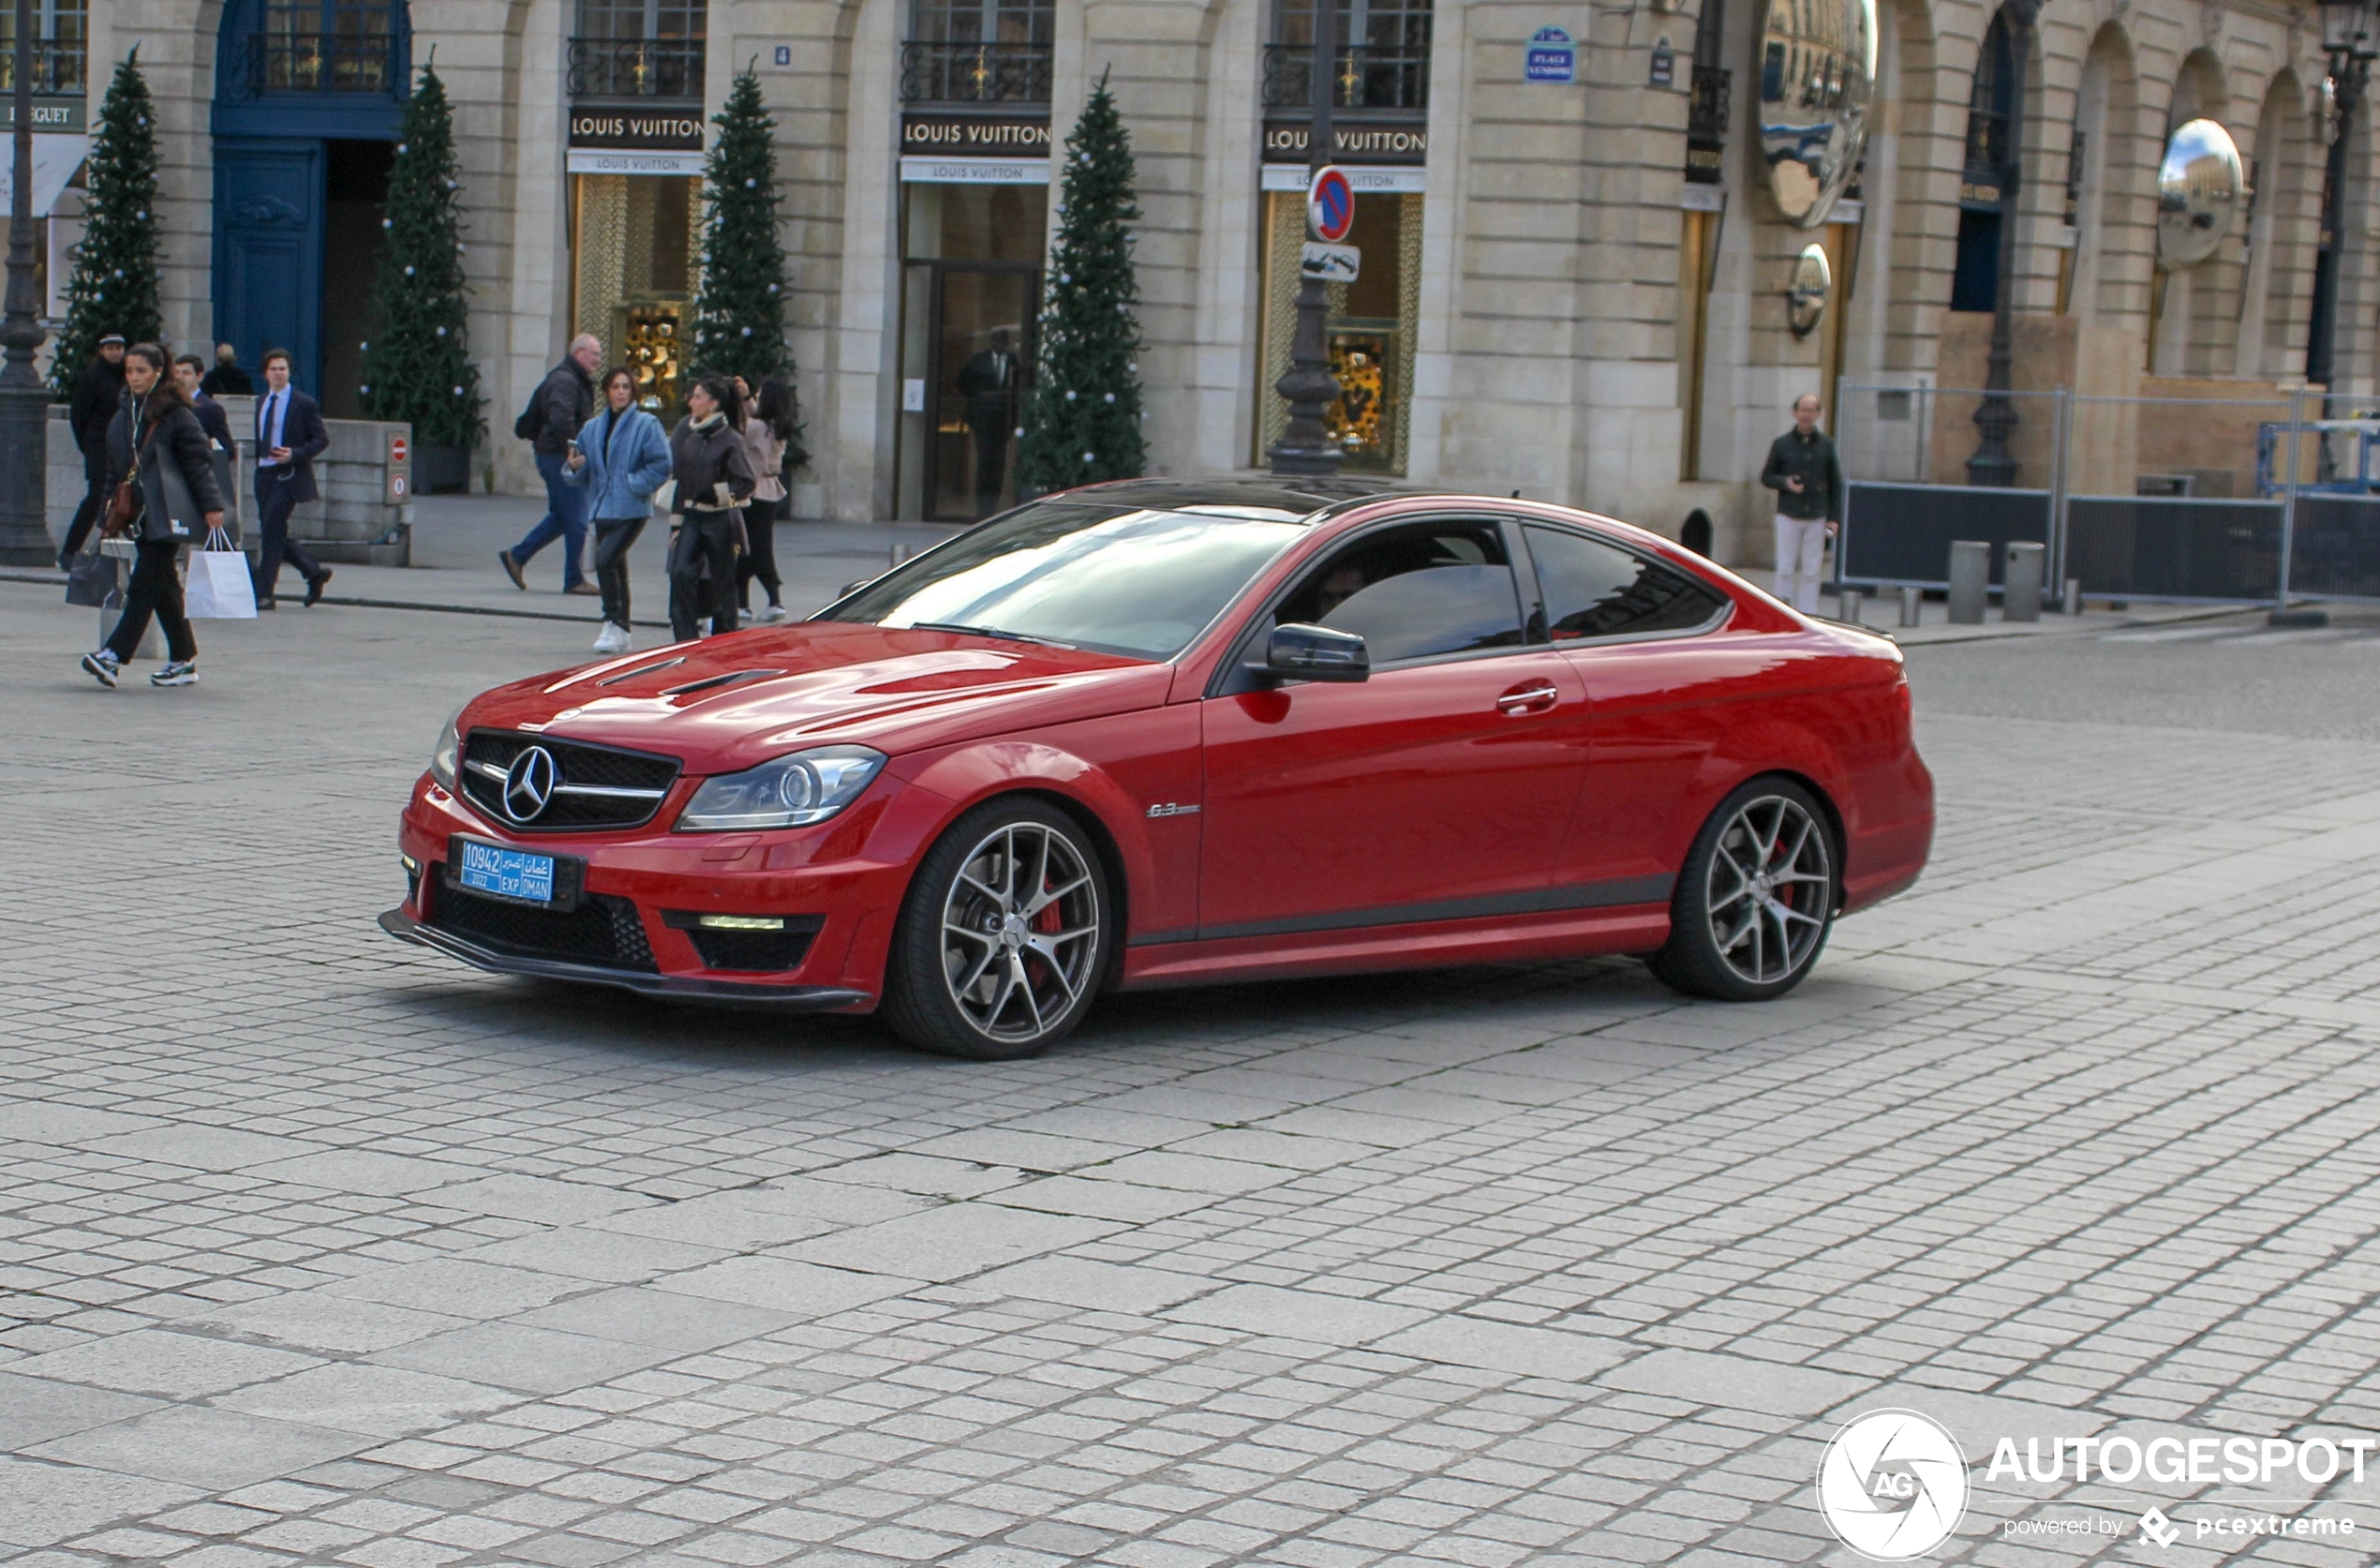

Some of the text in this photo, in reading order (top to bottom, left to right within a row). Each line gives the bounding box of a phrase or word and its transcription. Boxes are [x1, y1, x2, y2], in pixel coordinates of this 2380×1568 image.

[778, 48, 787, 63] 4
[572, 118, 706, 138] LOUIS VUITTON
[905, 124, 1051, 145] LOUIS VUITTON
[1267, 130, 1426, 152] LOU VUITTON
[597, 158, 680, 170] LOUIS VUITTON
[933, 166, 1023, 179] LOUIS VUITTON
[1351, 175, 1394, 187] UITTON
[466, 844, 500, 874] 10942
[471, 874, 548, 897] 2022 EXP OMAN
